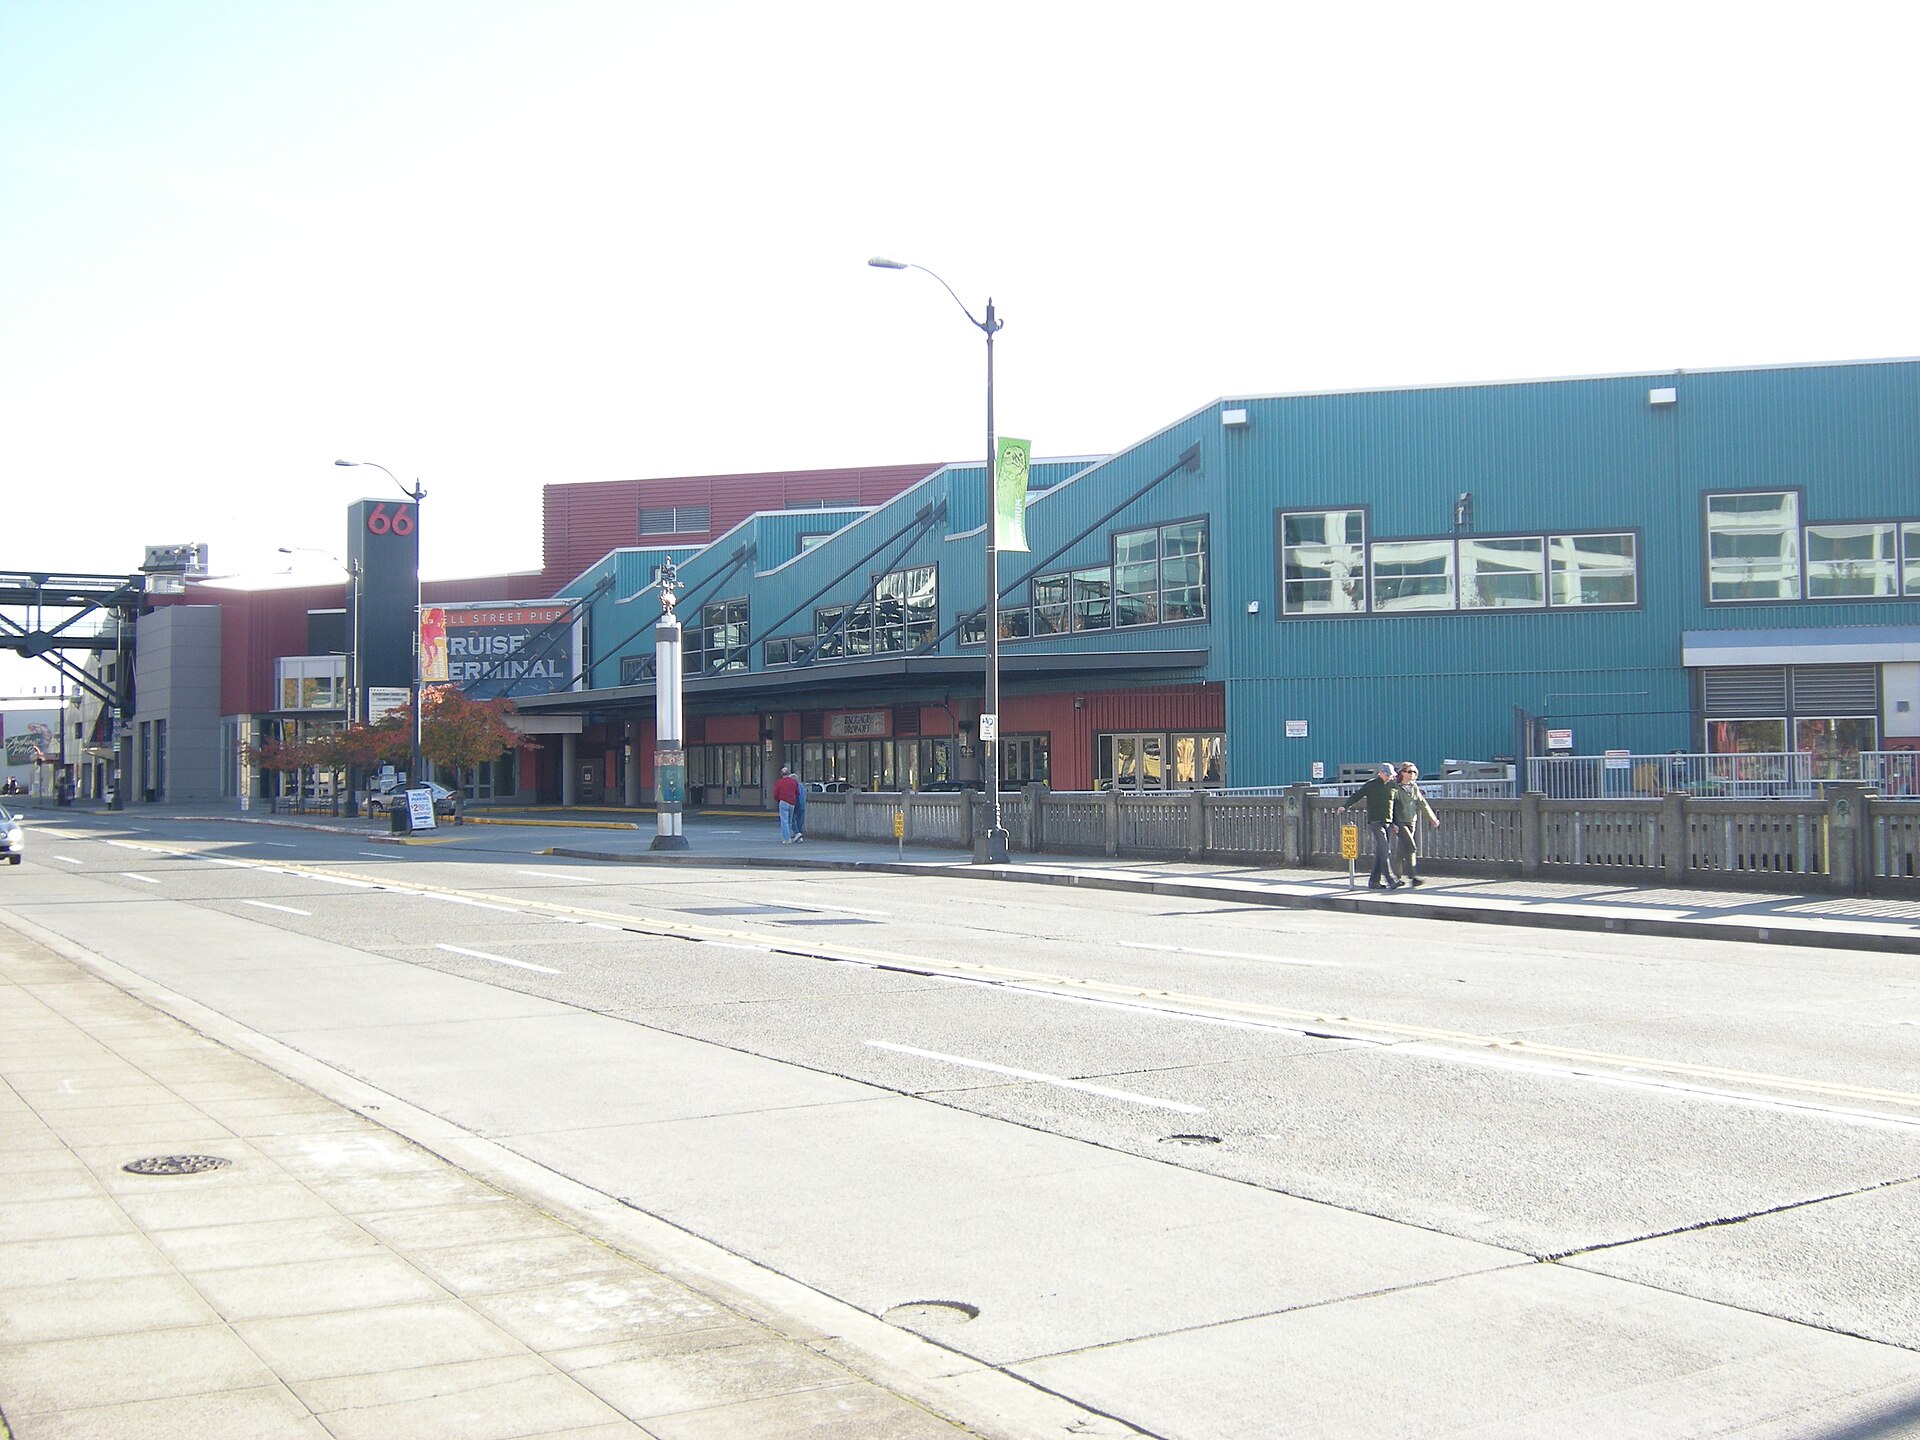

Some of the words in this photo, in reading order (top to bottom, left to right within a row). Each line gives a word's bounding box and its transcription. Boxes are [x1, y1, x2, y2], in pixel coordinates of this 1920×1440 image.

[368, 503, 414, 535] 66
[444, 615, 465, 624] ELL
[473, 612, 522, 623] STREET
[530, 611, 562, 621] PIER
[446, 634, 526, 656] RUISE
[448, 658, 564, 680] ERMINAL
